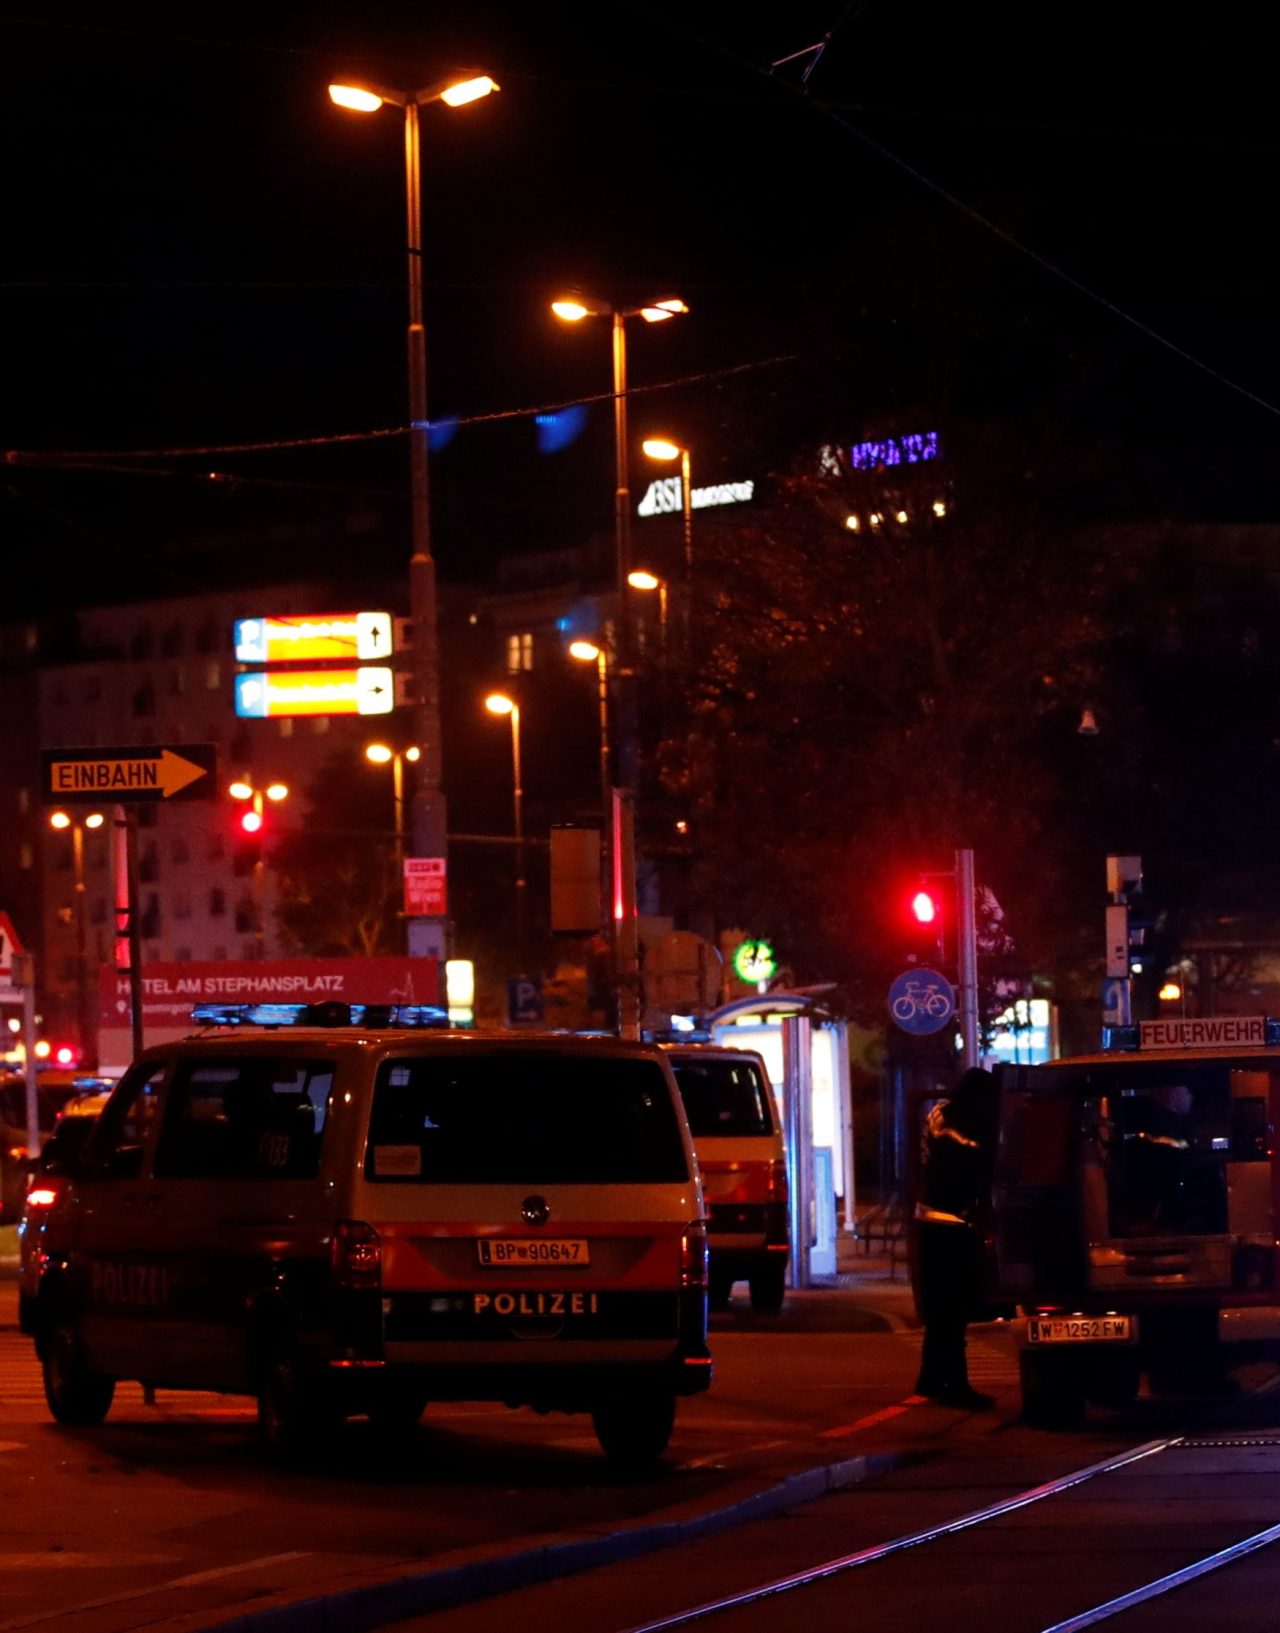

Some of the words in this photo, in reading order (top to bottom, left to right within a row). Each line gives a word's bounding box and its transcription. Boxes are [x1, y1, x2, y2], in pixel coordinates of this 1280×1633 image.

[59, 763, 157, 788] EINBAHN
[117, 979, 173, 994] HTEL
[175, 978, 200, 993] AM
[204, 975, 344, 993] STEPHANSPLATZ
[1142, 1021, 1263, 1046] FEUERWEHR
[528, 1243, 580, 1260] 90647
[91, 1261, 169, 1304] POLIZEI
[473, 1292, 598, 1315] POLIZEI
[1064, 1322, 1099, 1337] 1252
[1103, 1321, 1124, 1337] FW
